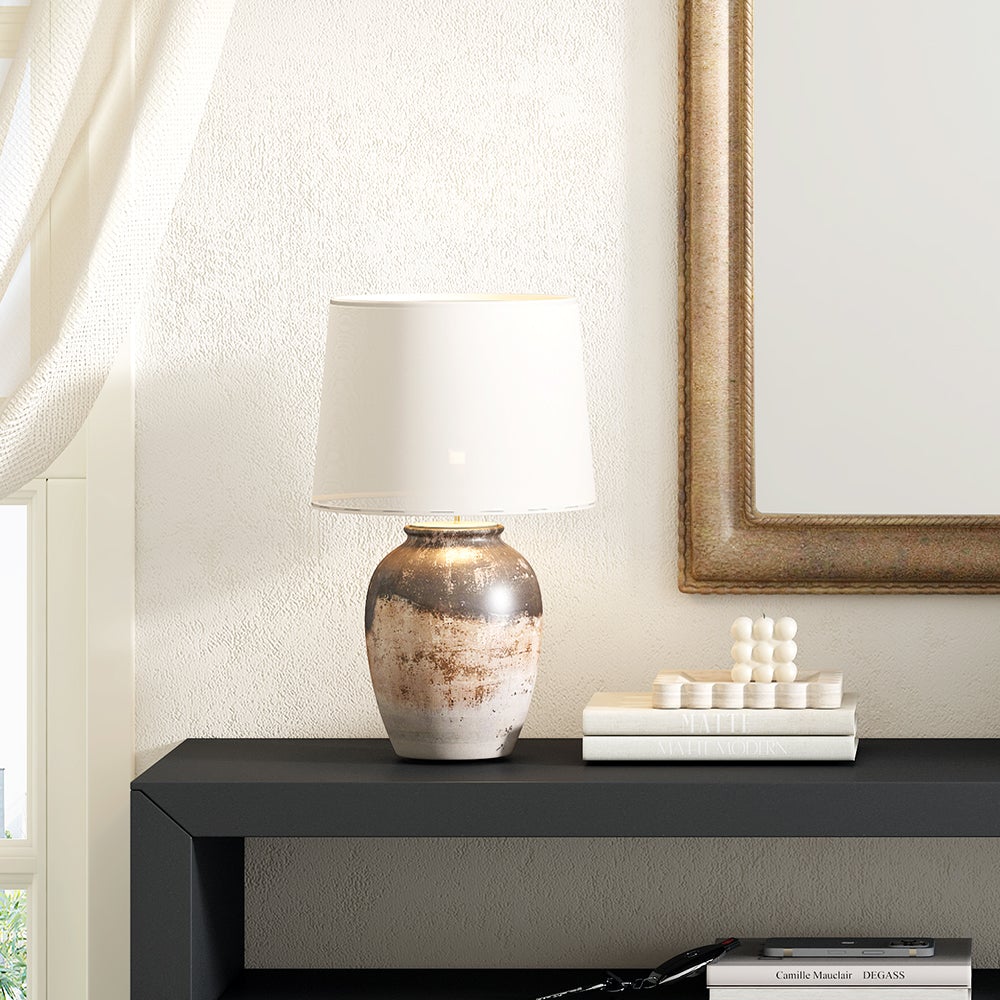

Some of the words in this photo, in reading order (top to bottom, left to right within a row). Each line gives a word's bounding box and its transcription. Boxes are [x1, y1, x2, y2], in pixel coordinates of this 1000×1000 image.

[775, 970, 811, 980] Camille
[813, 970, 853, 980] Mauclair
[863, 970, 906, 980] DEGASS
